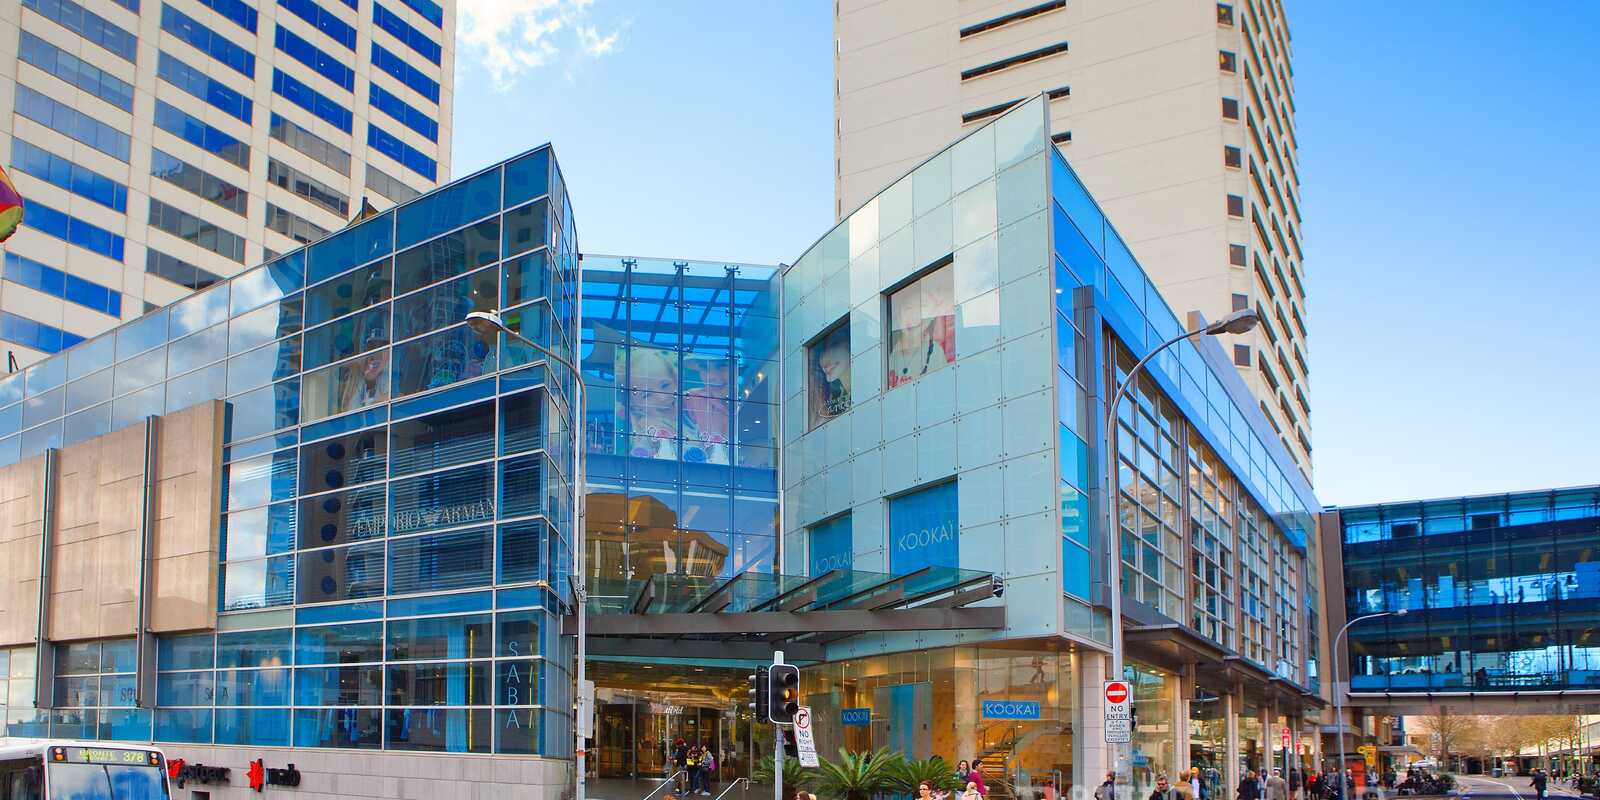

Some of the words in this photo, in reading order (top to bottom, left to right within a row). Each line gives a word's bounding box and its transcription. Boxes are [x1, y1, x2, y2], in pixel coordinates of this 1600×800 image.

[352, 511, 420, 536] EMPRIO
[441, 498, 495, 523] ARMAN
[506, 641, 521, 728] SABA
[799, 730, 809, 738] NO
[123, 751, 145, 762] 378
